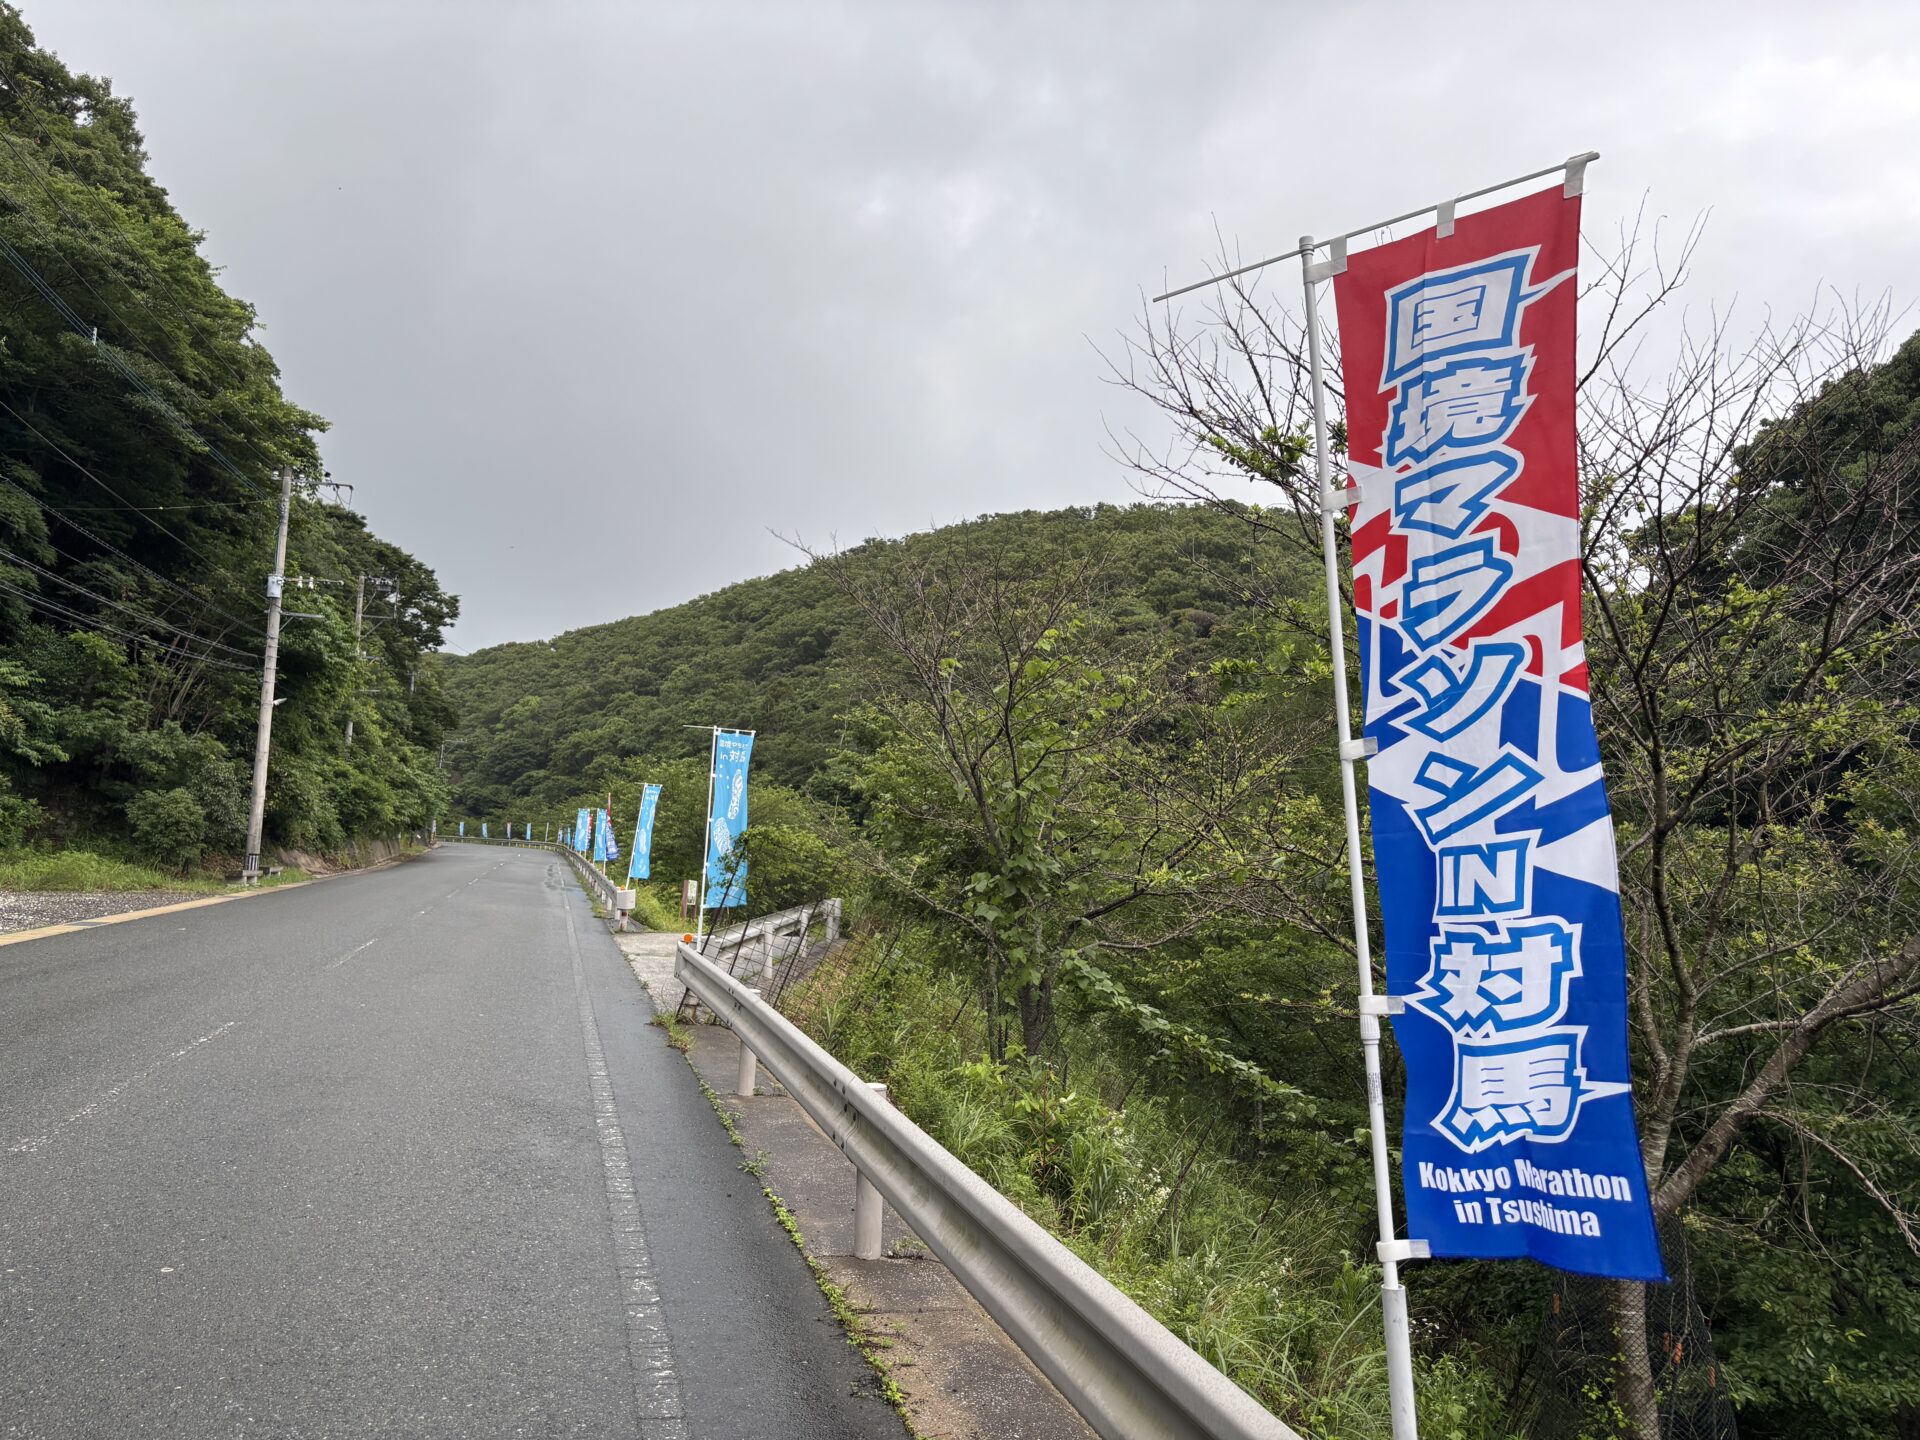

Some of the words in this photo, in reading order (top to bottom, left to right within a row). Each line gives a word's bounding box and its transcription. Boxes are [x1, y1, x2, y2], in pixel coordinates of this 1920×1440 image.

[1418, 1161, 1512, 1193] Kokkyo
[1513, 1158, 1633, 1202] Marathon
[1453, 1199, 1483, 1225] in
[1485, 1197, 1601, 1237] Tsushima
